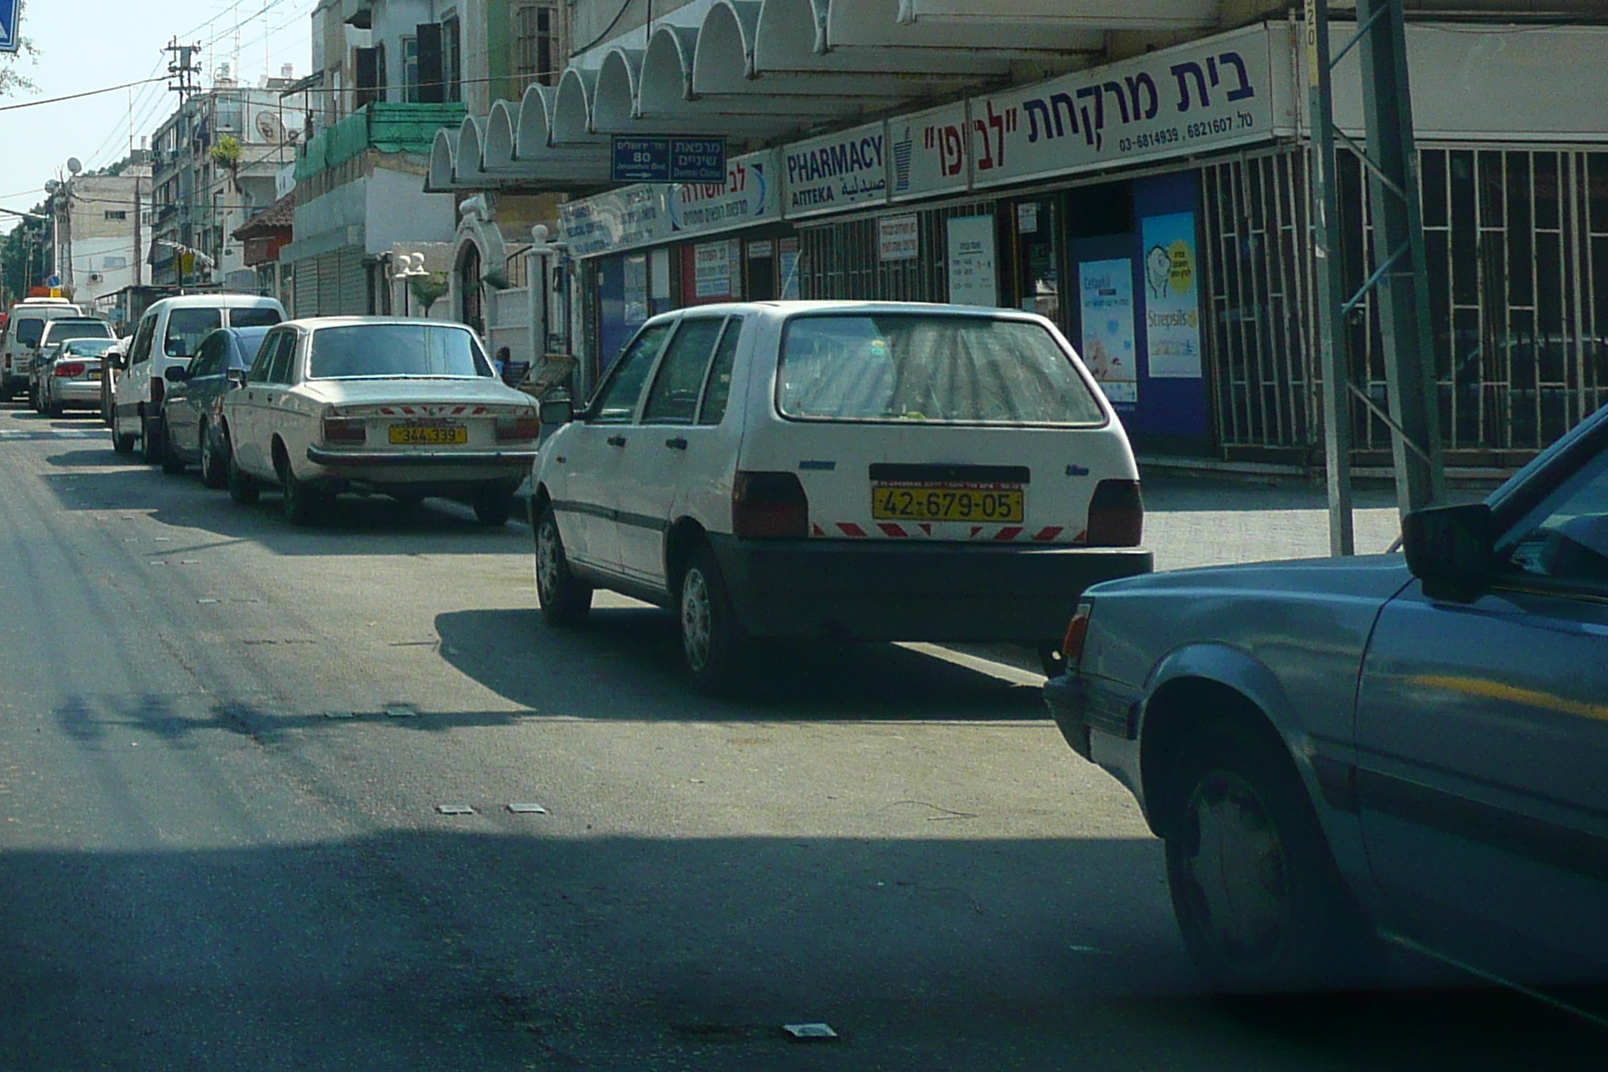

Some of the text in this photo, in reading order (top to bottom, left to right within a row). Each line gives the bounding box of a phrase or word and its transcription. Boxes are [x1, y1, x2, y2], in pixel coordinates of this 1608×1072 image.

[1170, 50, 1255, 112] בית
[1023, 71, 1159, 151] מרקחת
[1119, 127, 1178, 153] 03-6814939
[1187, 116, 1233, 140] 6821607
[633, 151, 651, 163] 80
[673, 142, 721, 153] מרפאת
[678, 155, 717, 166] שיניים
[787, 134, 884, 184] PHARMACY
[729, 161, 746, 193] לב
[840, 174, 886, 202] صيدلية
[792, 184, 835, 208] АПТЕКА
[1148, 308, 1188, 330] Strepsils
[883, 491, 1012, 518] 42-679-05
